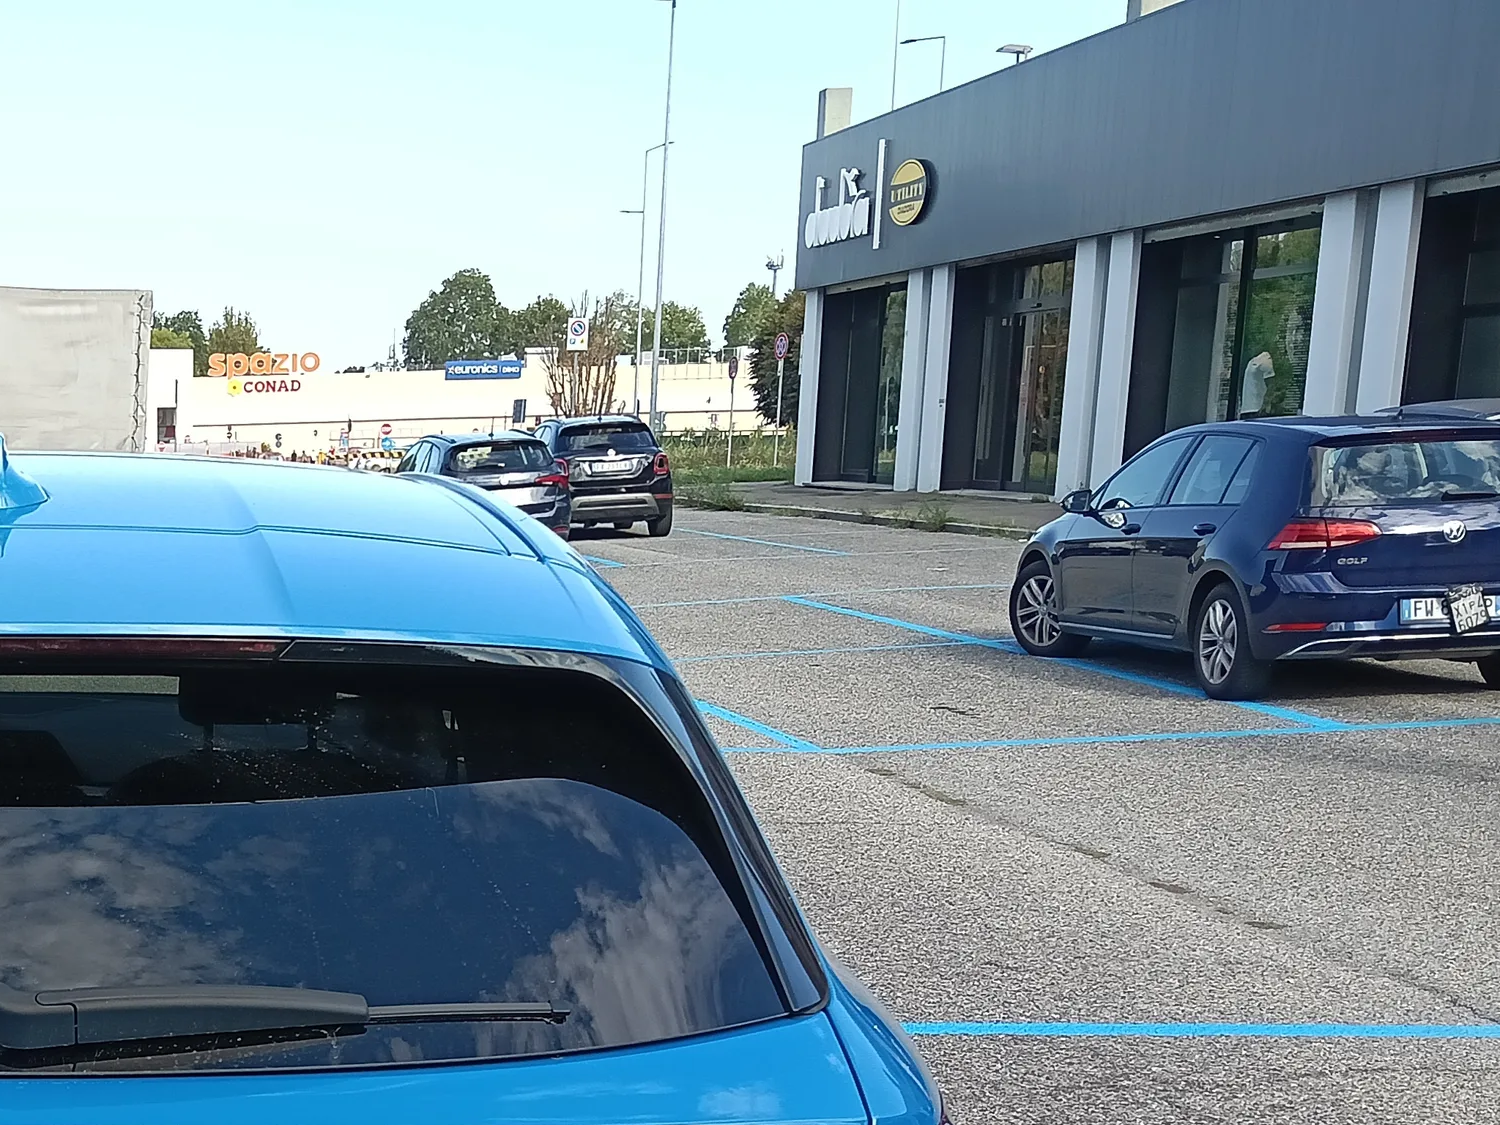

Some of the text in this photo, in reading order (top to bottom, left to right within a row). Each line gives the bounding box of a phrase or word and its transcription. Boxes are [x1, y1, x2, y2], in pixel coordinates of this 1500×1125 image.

[454, 363, 498, 375] euronics
[244, 380, 301, 393] CONAD
[1337, 557, 1368, 565] GOLF
